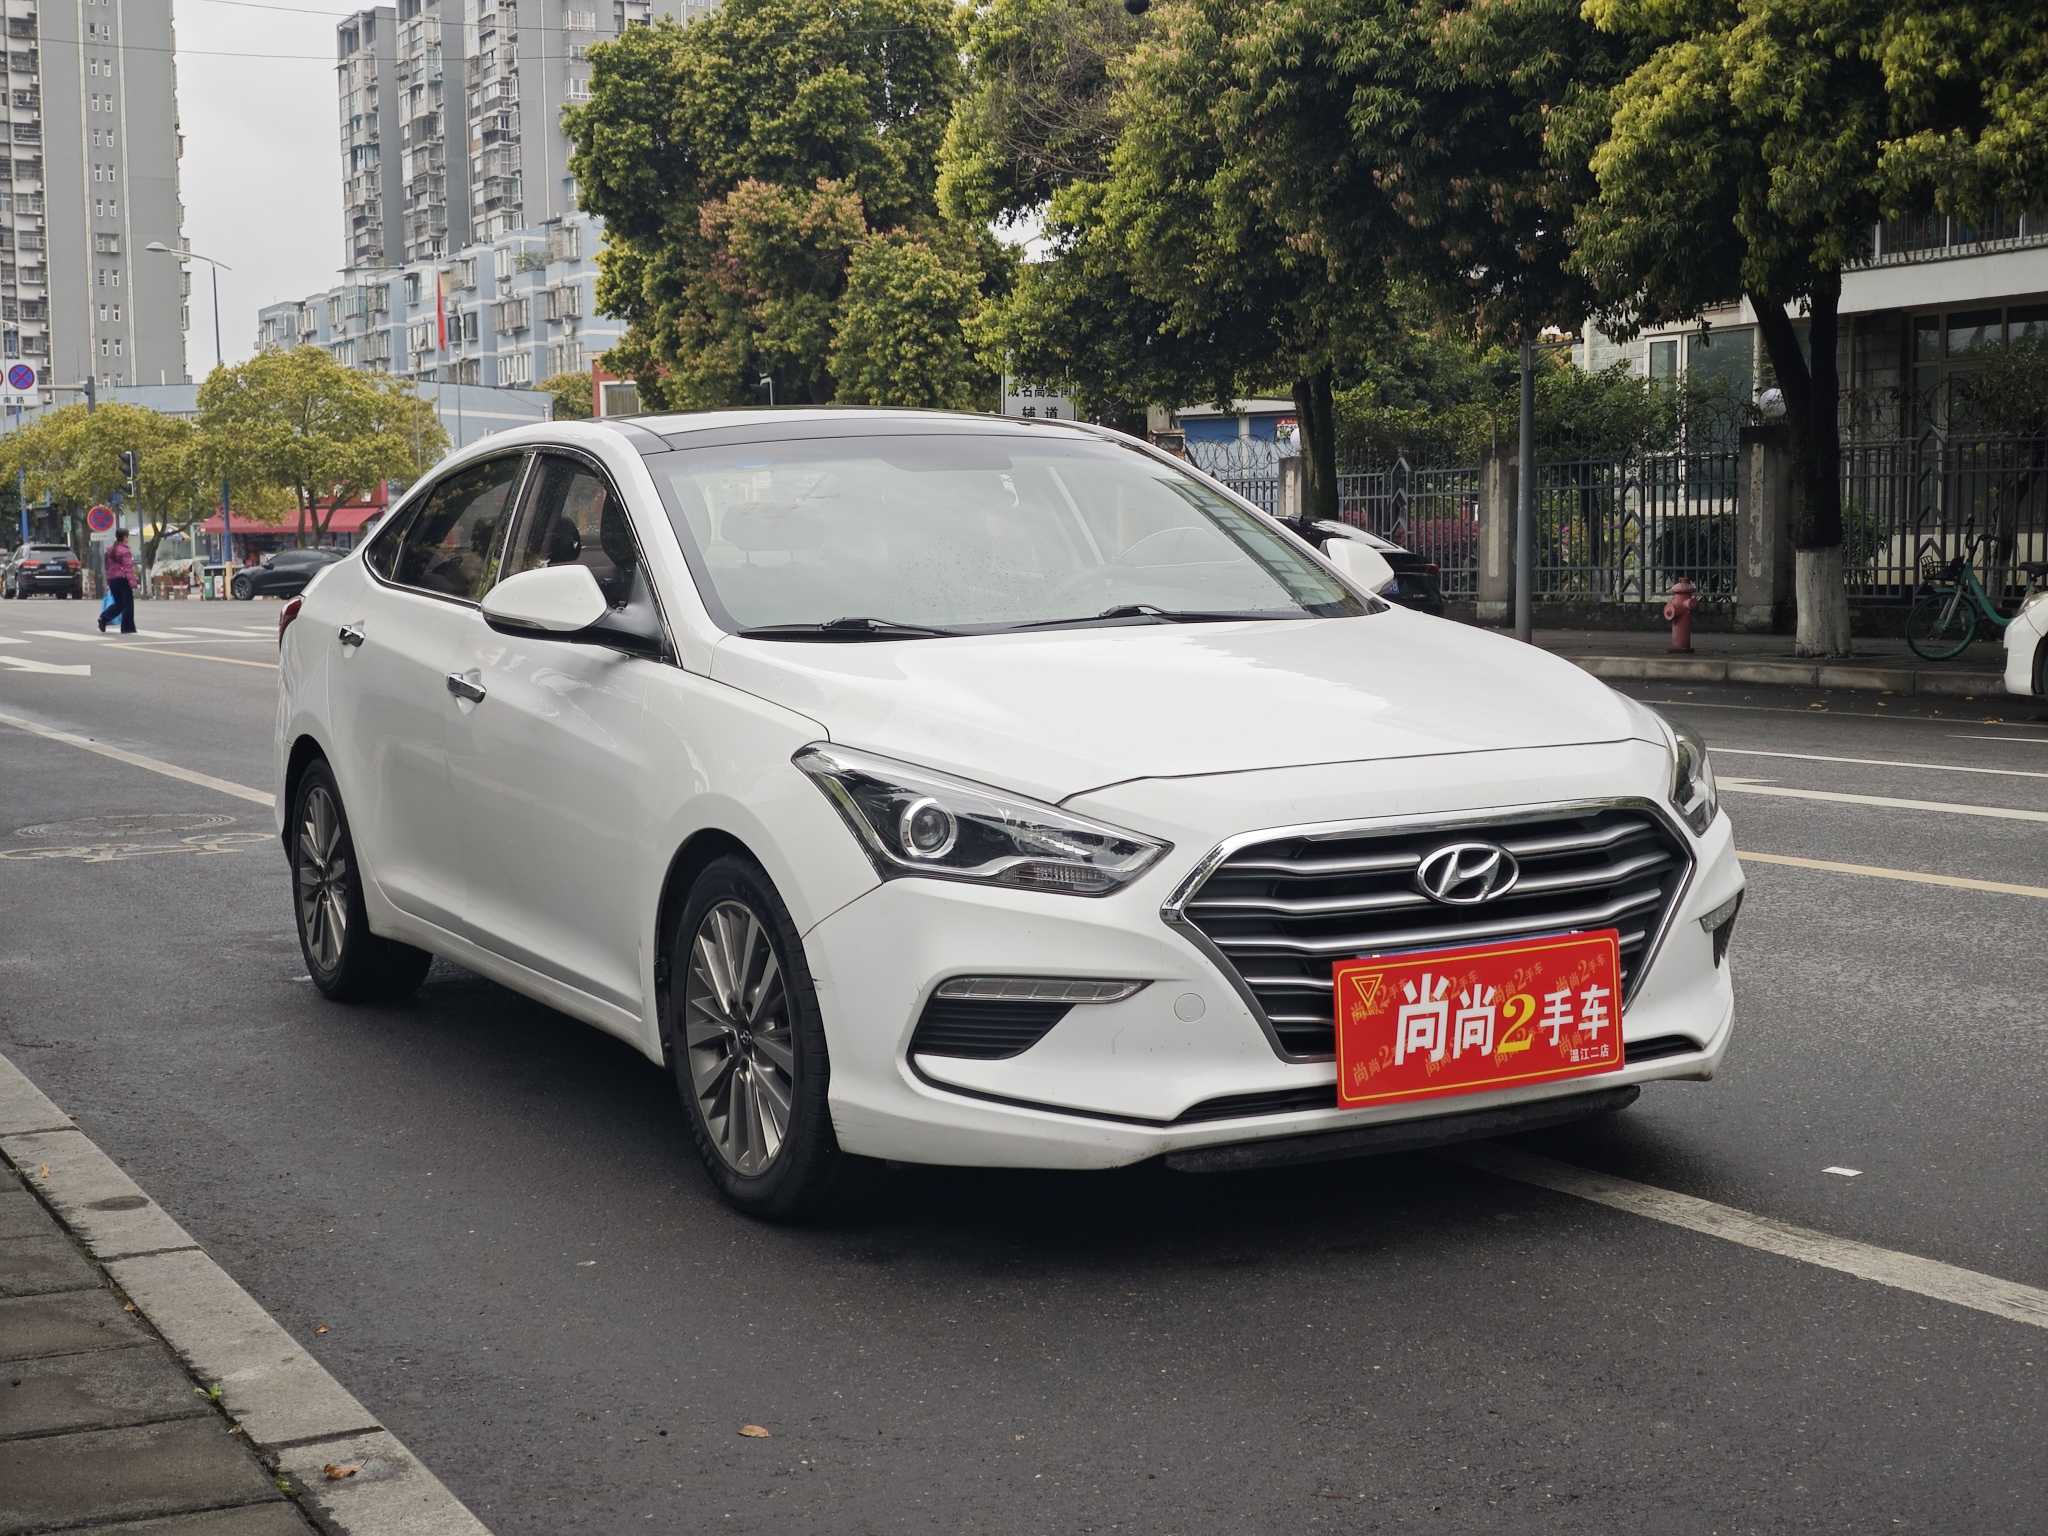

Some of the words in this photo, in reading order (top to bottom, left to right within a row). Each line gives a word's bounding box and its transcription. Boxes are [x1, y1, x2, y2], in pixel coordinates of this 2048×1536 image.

[1395, 973, 1610, 1065] 尚尚2手车
[1570, 1044, 1609, 1061] 温江二店
